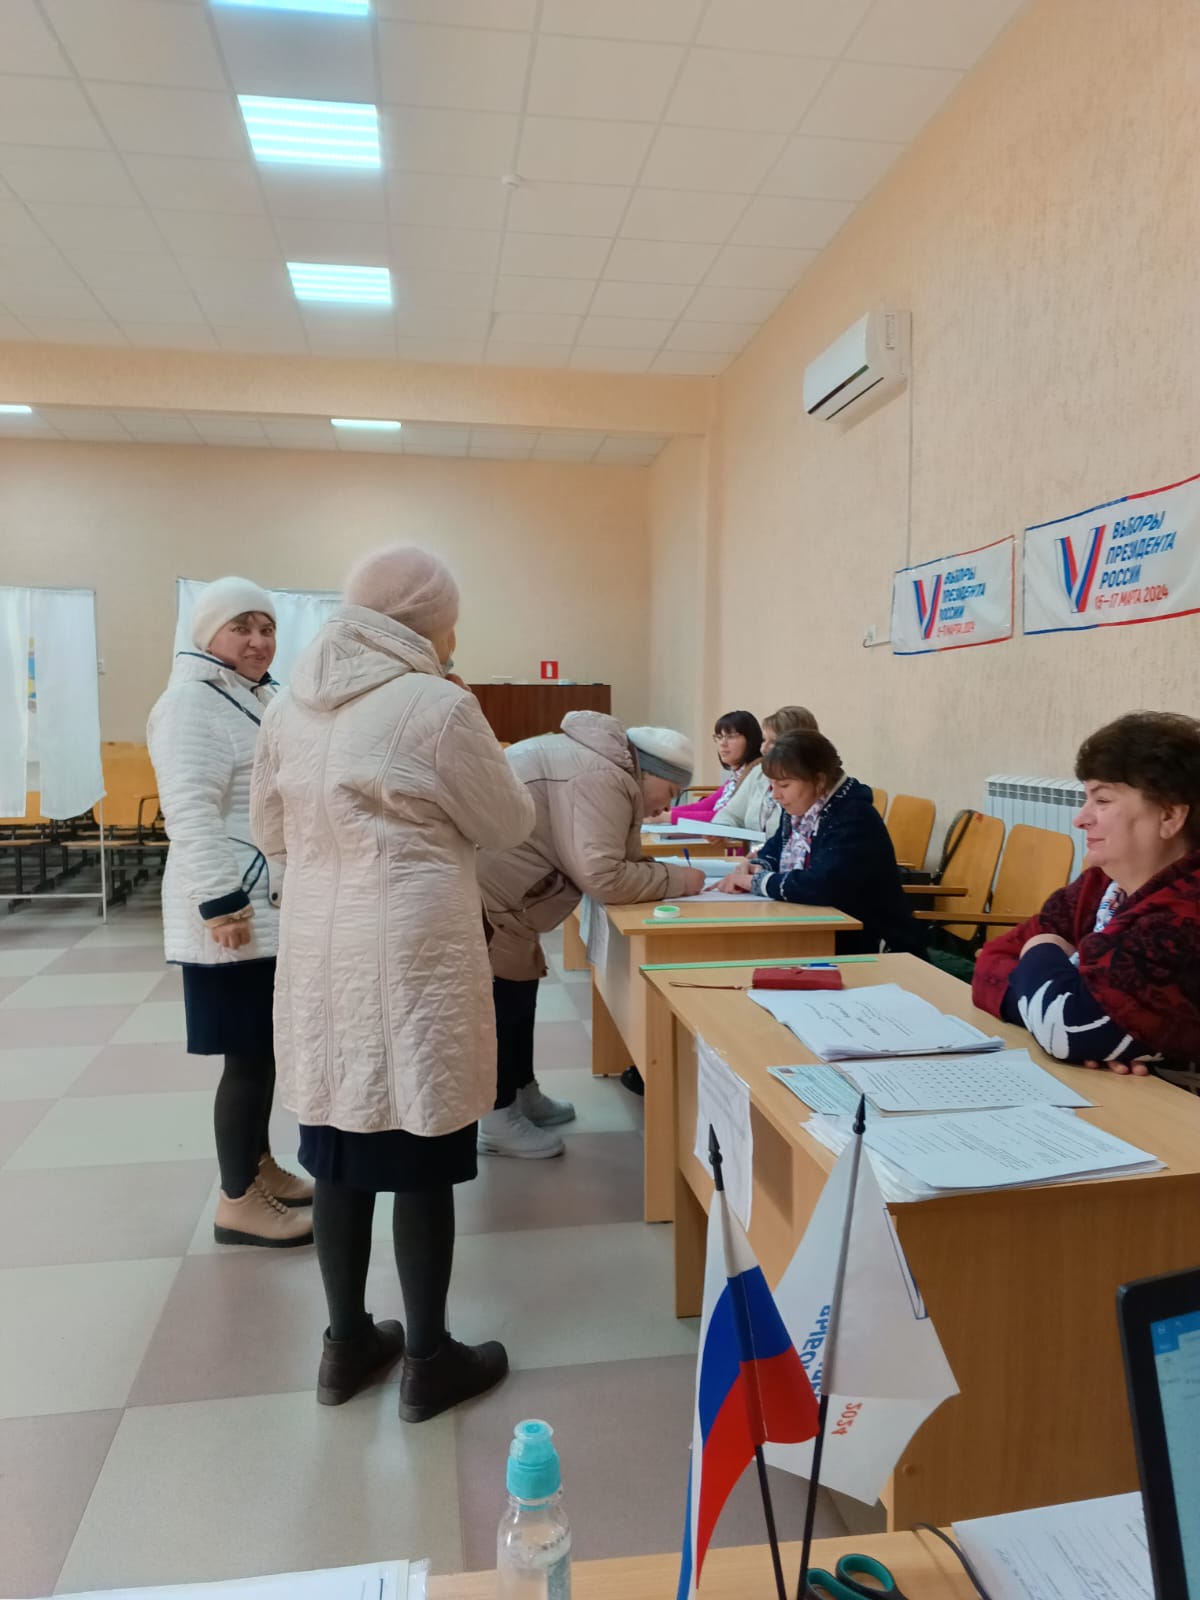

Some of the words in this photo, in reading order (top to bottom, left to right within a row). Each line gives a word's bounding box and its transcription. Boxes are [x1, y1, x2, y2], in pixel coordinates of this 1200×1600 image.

[1112, 510, 1166, 540] ВЫБОРЫ
[1105, 531, 1177, 565] ПРЕЗИДЕНТА
[1100, 564, 1142, 589] РОССИИ
[1143, 584, 1169, 602] 2024
